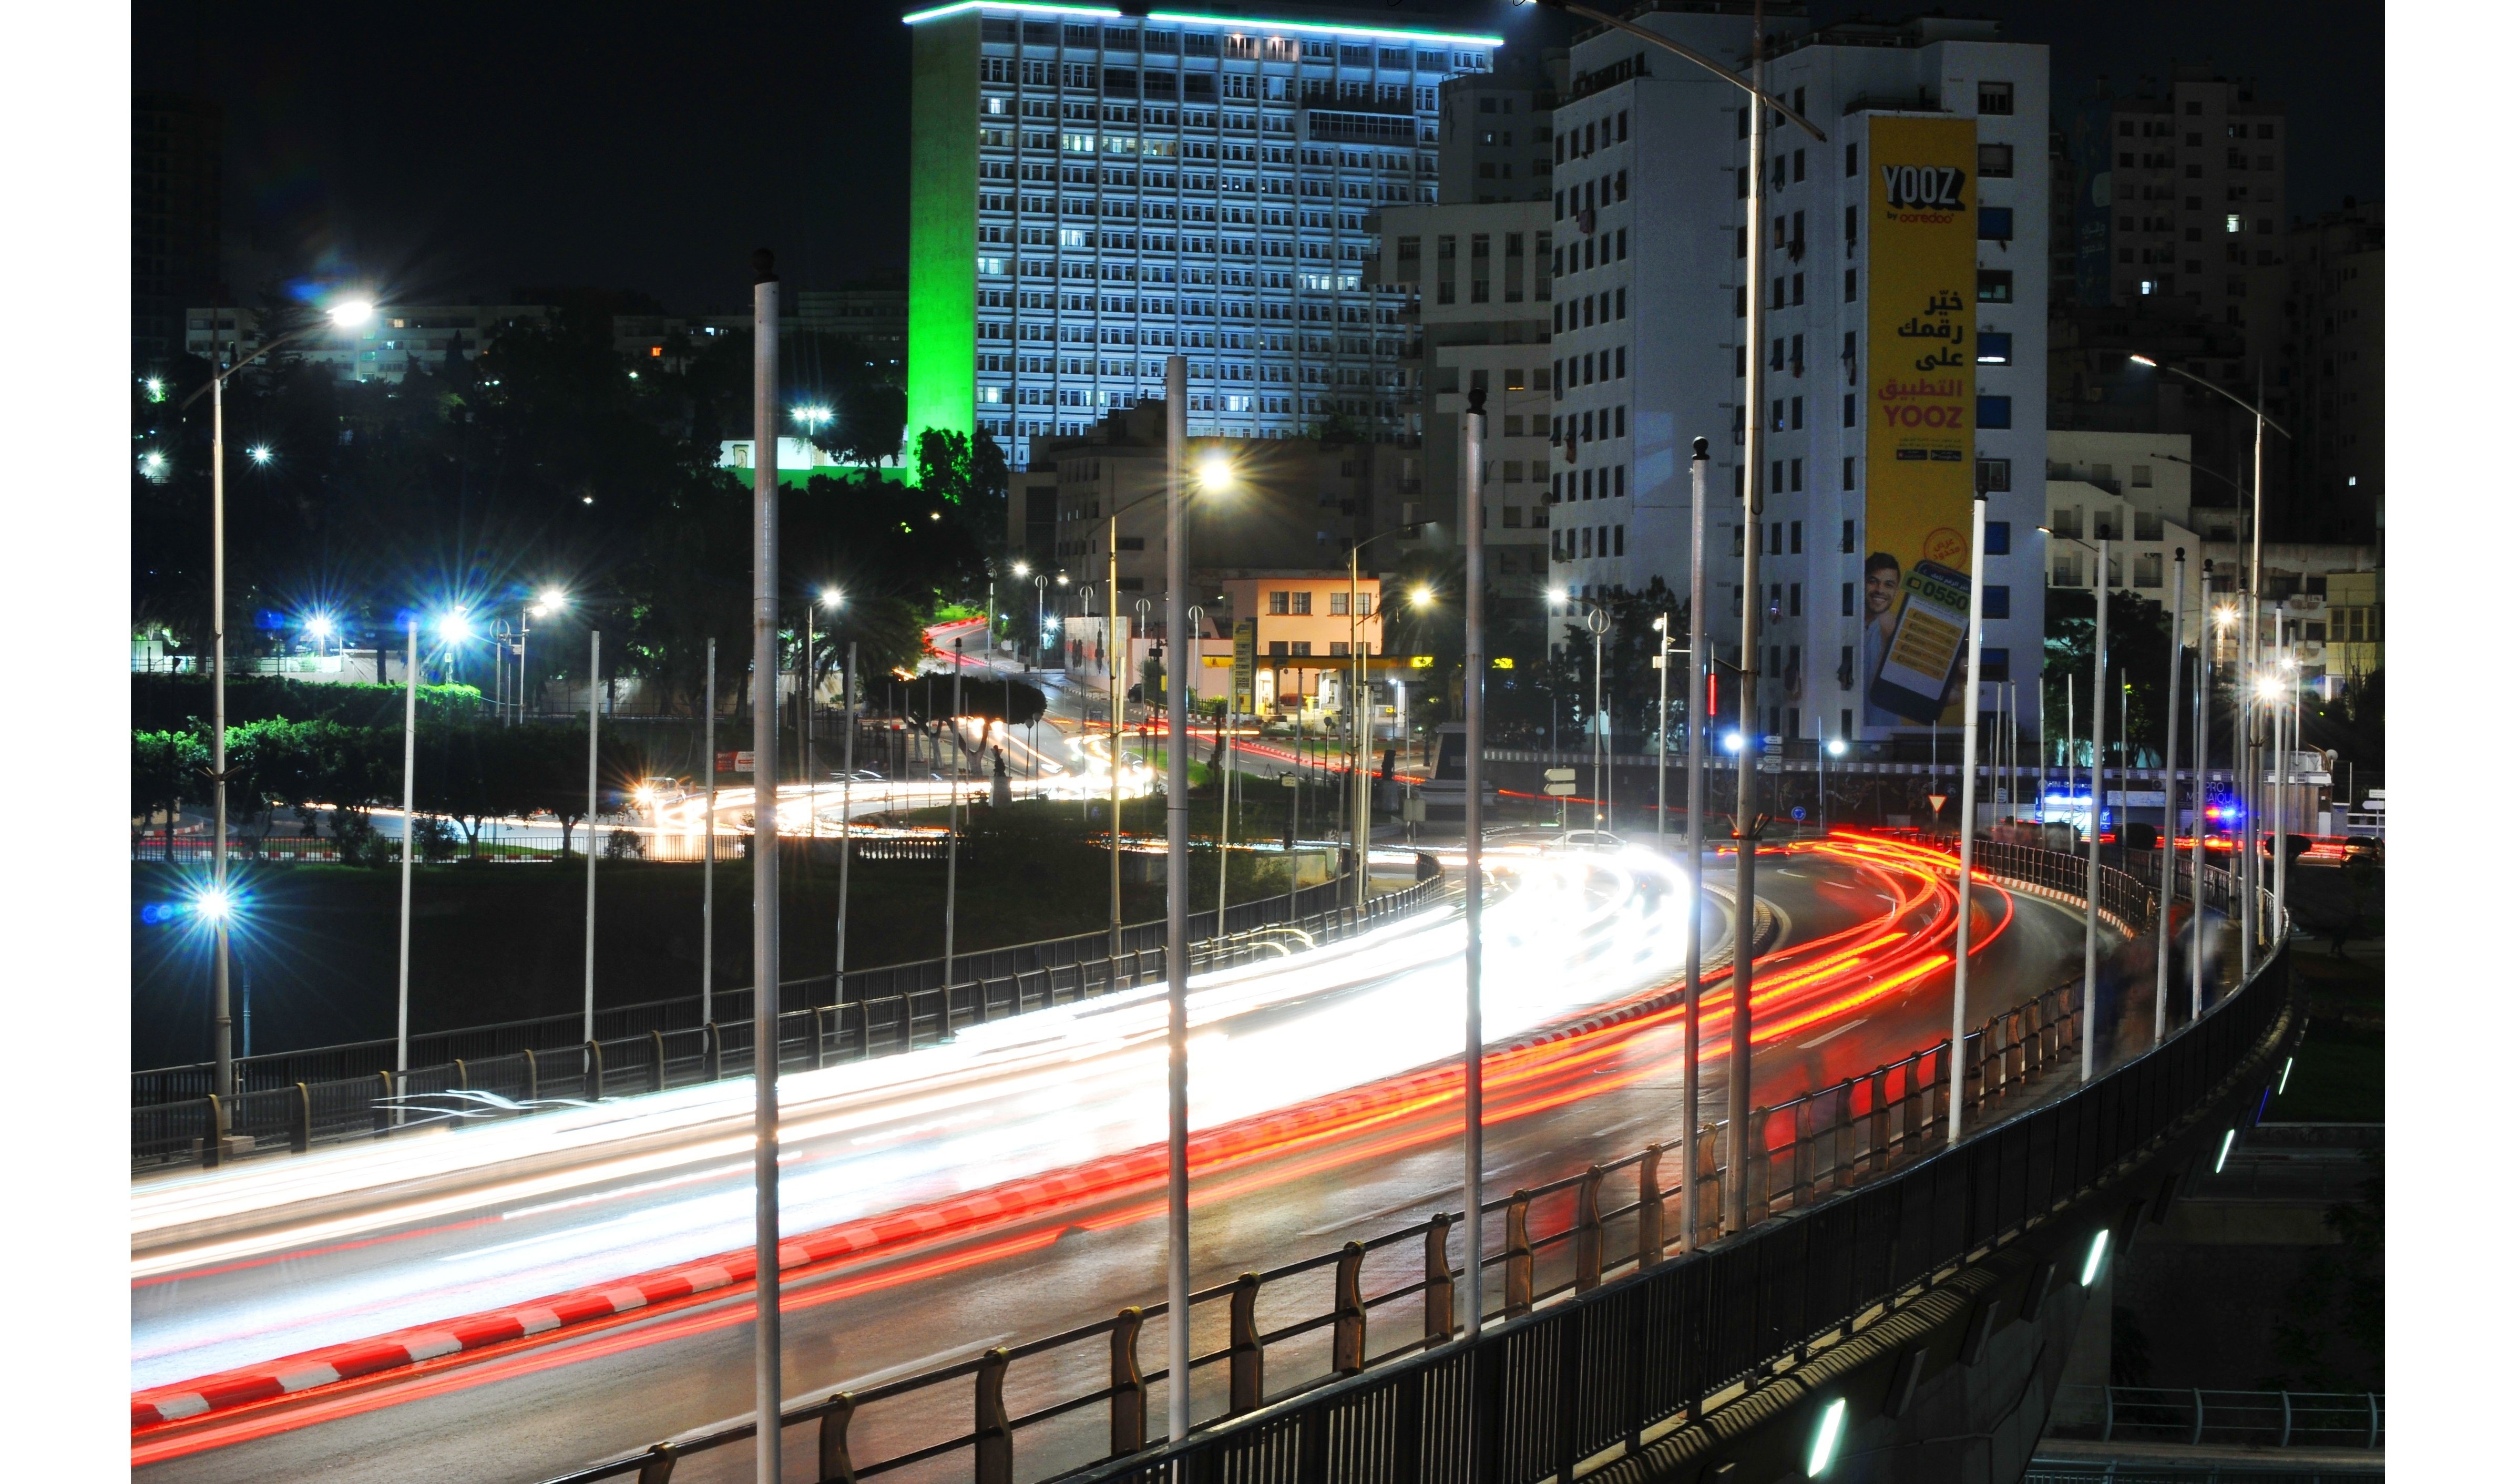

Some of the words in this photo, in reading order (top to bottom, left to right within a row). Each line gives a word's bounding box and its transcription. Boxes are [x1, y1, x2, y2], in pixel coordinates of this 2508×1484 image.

[1881, 165, 1956, 204] YOOZ
[1887, 211, 1897, 220] by
[1900, 212, 1952, 223] ooredoo
[1898, 318, 1963, 344] رقمك
[1916, 346, 1963, 371] على
[1878, 378, 1963, 401] التطبيق
[1883, 405, 1963, 428] YOOZ
[1923, 581, 1969, 610] 0550
